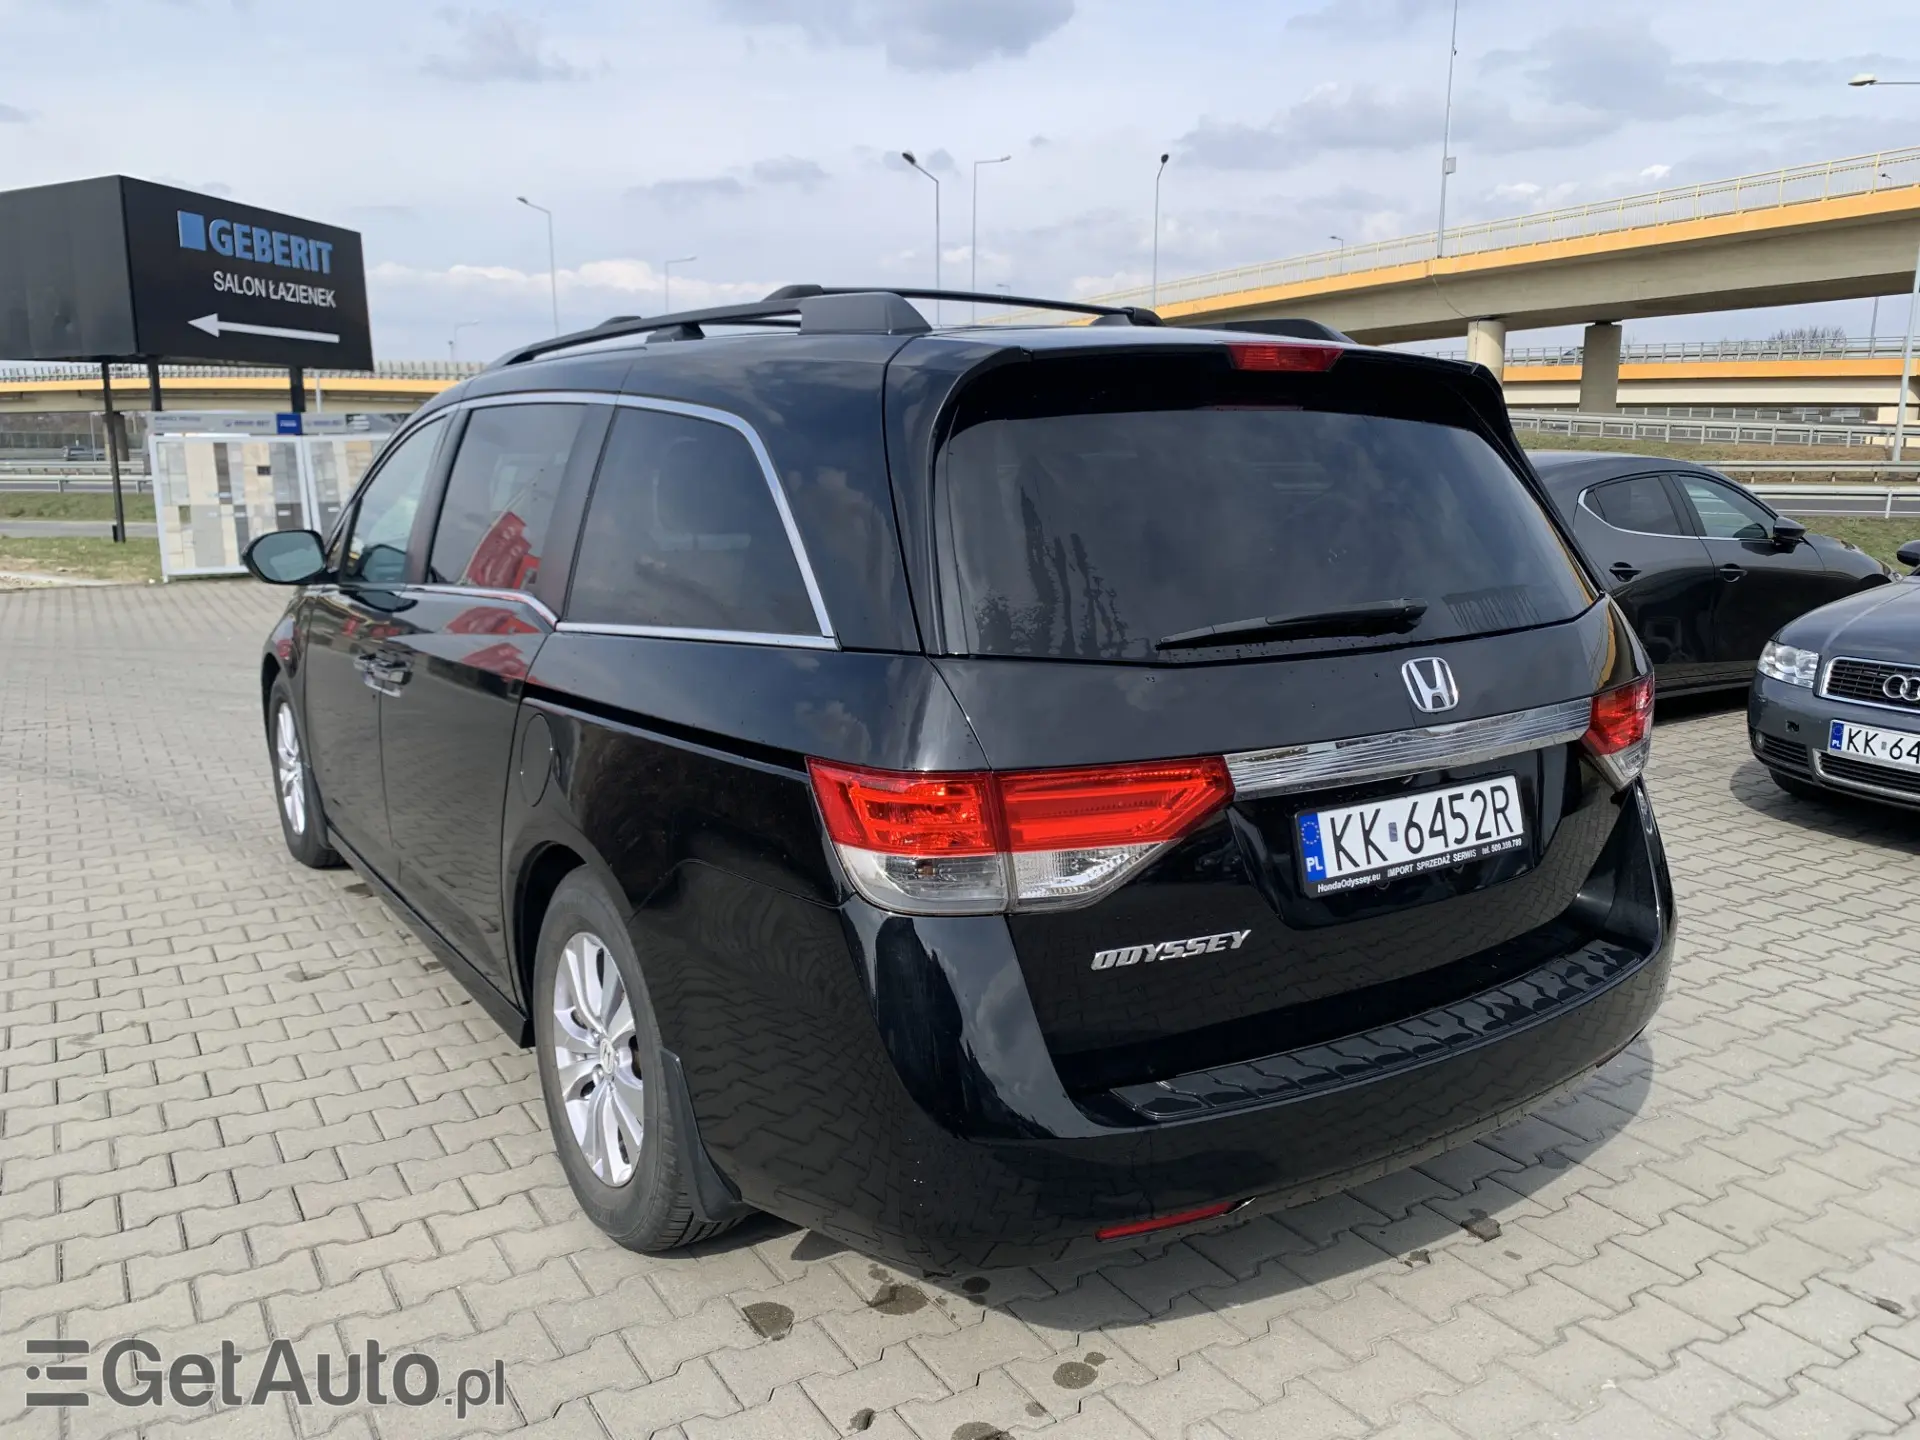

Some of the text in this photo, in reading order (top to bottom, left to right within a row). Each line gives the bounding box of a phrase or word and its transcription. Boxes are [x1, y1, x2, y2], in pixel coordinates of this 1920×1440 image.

[208, 218, 333, 275] GEBERIT
[213, 270, 337, 309] SALON ŁAZIENEK
[1831, 740, 1841, 748] PL
[1846, 728, 1880, 757] KK
[1329, 785, 1515, 871] KK 6452R
[1305, 856, 1324, 873] PL
[1317, 873, 1381, 894] HondaOdyssey.eu
[1387, 863, 1414, 878] IMPORT
[1416, 853, 1451, 871] SPRZEDAŻ
[1452, 848, 1477, 863] SERWIS
[1090, 929, 1252, 971] ODYSSEY
